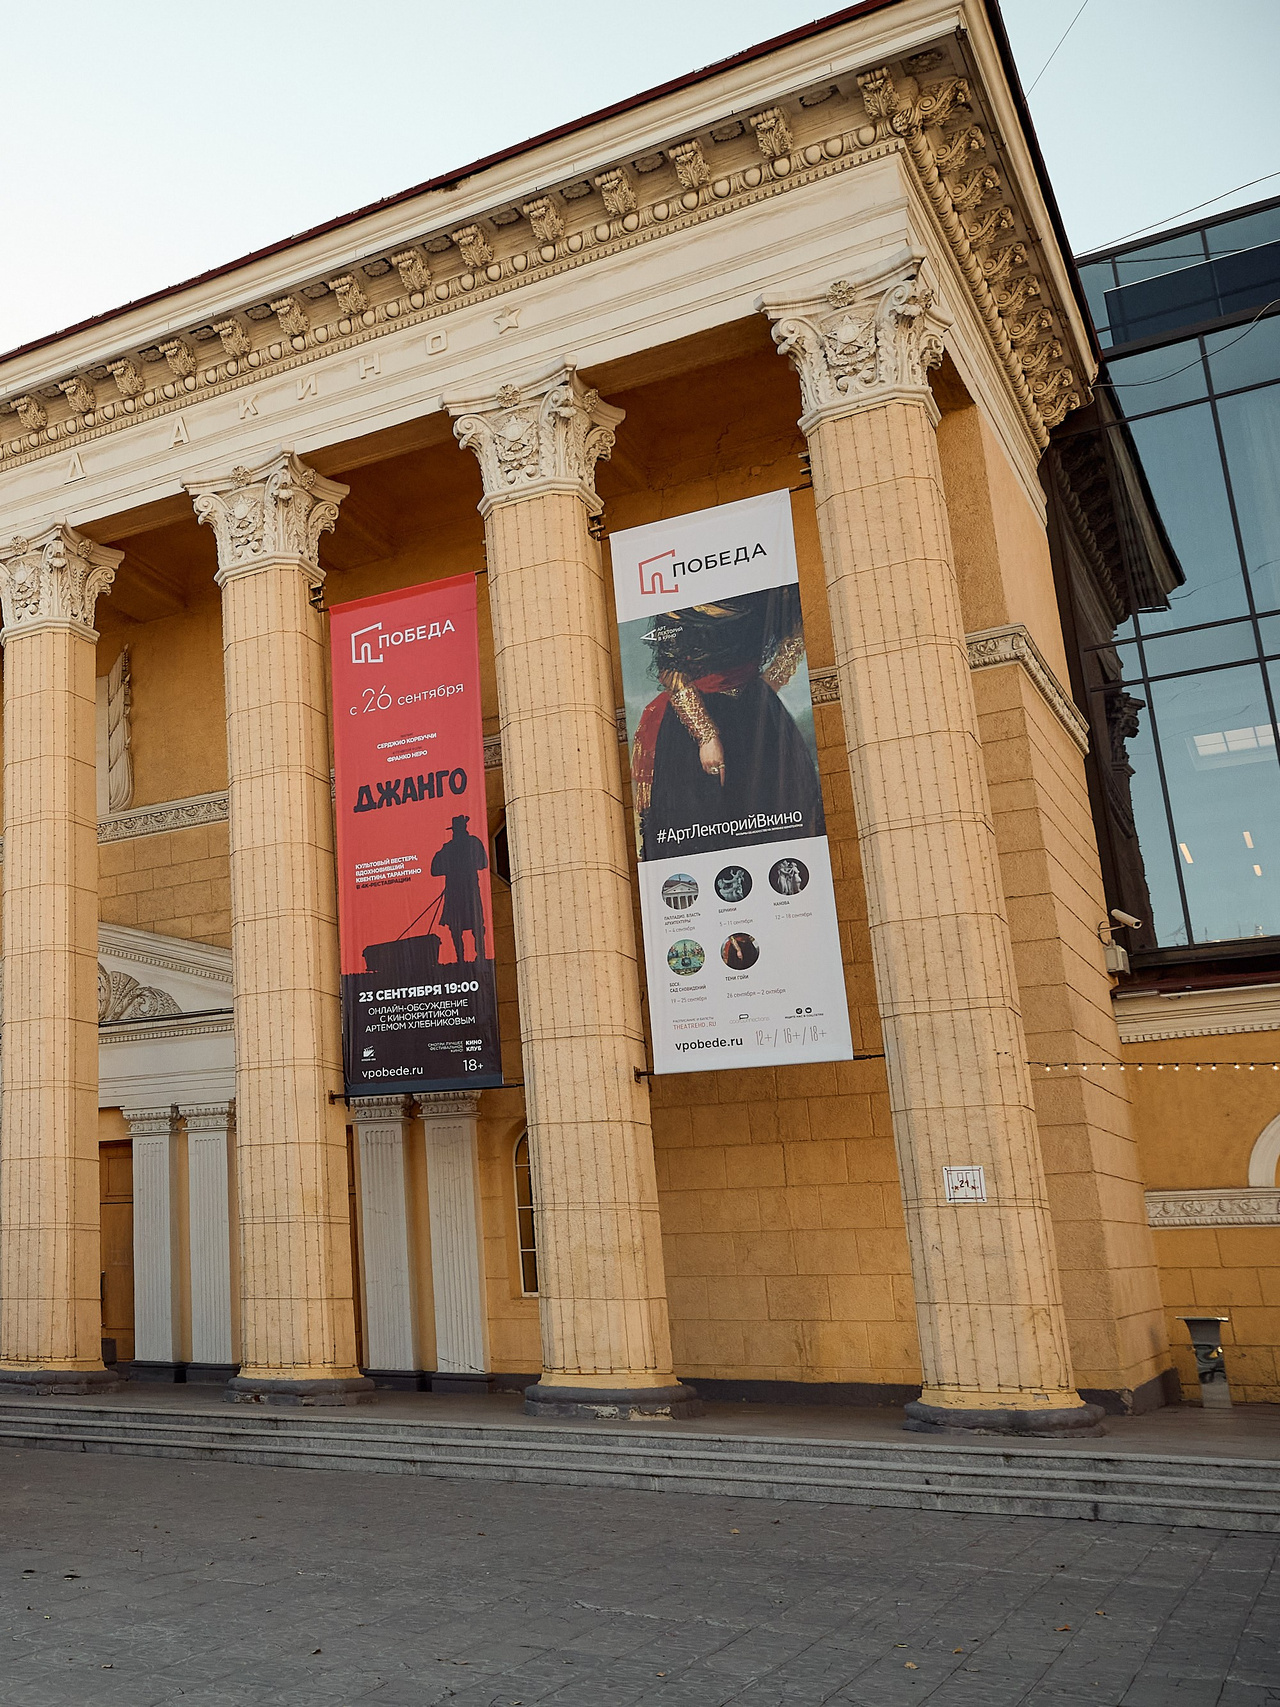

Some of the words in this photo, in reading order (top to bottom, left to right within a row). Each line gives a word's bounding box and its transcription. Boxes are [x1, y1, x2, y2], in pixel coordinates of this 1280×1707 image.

[238, 329, 448, 420] КИНО
[672, 542, 767, 578] ПОБЕДА
[378, 619, 455, 649] ПОБЕДА
[349, 706, 358, 716] с
[362, 685, 392, 713] 26
[397, 683, 464, 706] сентября
[377, 739, 406, 750] СЕРДЖИО
[406, 732, 437, 744] КОРБУЧЧИ
[387, 753, 411, 762] ФРАНКО
[412, 750, 428, 758] НЕРО
[353, 767, 467, 813] ДЖАНГО
[656, 810, 803, 844] #АртЛекторийВкино
[355, 857, 390, 870] КУЛЬТОВЫЙ
[355, 863, 405, 877] ВДОХНОВИВШИЙ
[355, 873, 386, 883] КВЕНТИНА
[387, 868, 422, 878] ТАРАНТИНО
[358, 991, 373, 1003] 23
[375, 984, 442, 1001] СЕНТЯБРЯ
[444, 980, 479, 994] 19:00
[368, 999, 469, 1016] ОНЛАЙН-ОБСУЖДЕНИЕ
[379, 1015, 386, 1023] С
[387, 1009, 459, 1022] КИНОКРИТИКОМ
[365, 1022, 407, 1033] АРТЕМОМ
[408, 1016, 476, 1030] ХЛЕБНИКОВЫМ
[755, 1030, 772, 1046] 12+
[783, 1028, 800, 1044] 16+
[810, 1025, 827, 1042] 18+
[675, 1037, 743, 1053] vpobede.ru
[361, 1065, 424, 1080] vpobede.ru
[462, 1058, 484, 1072] 18+
